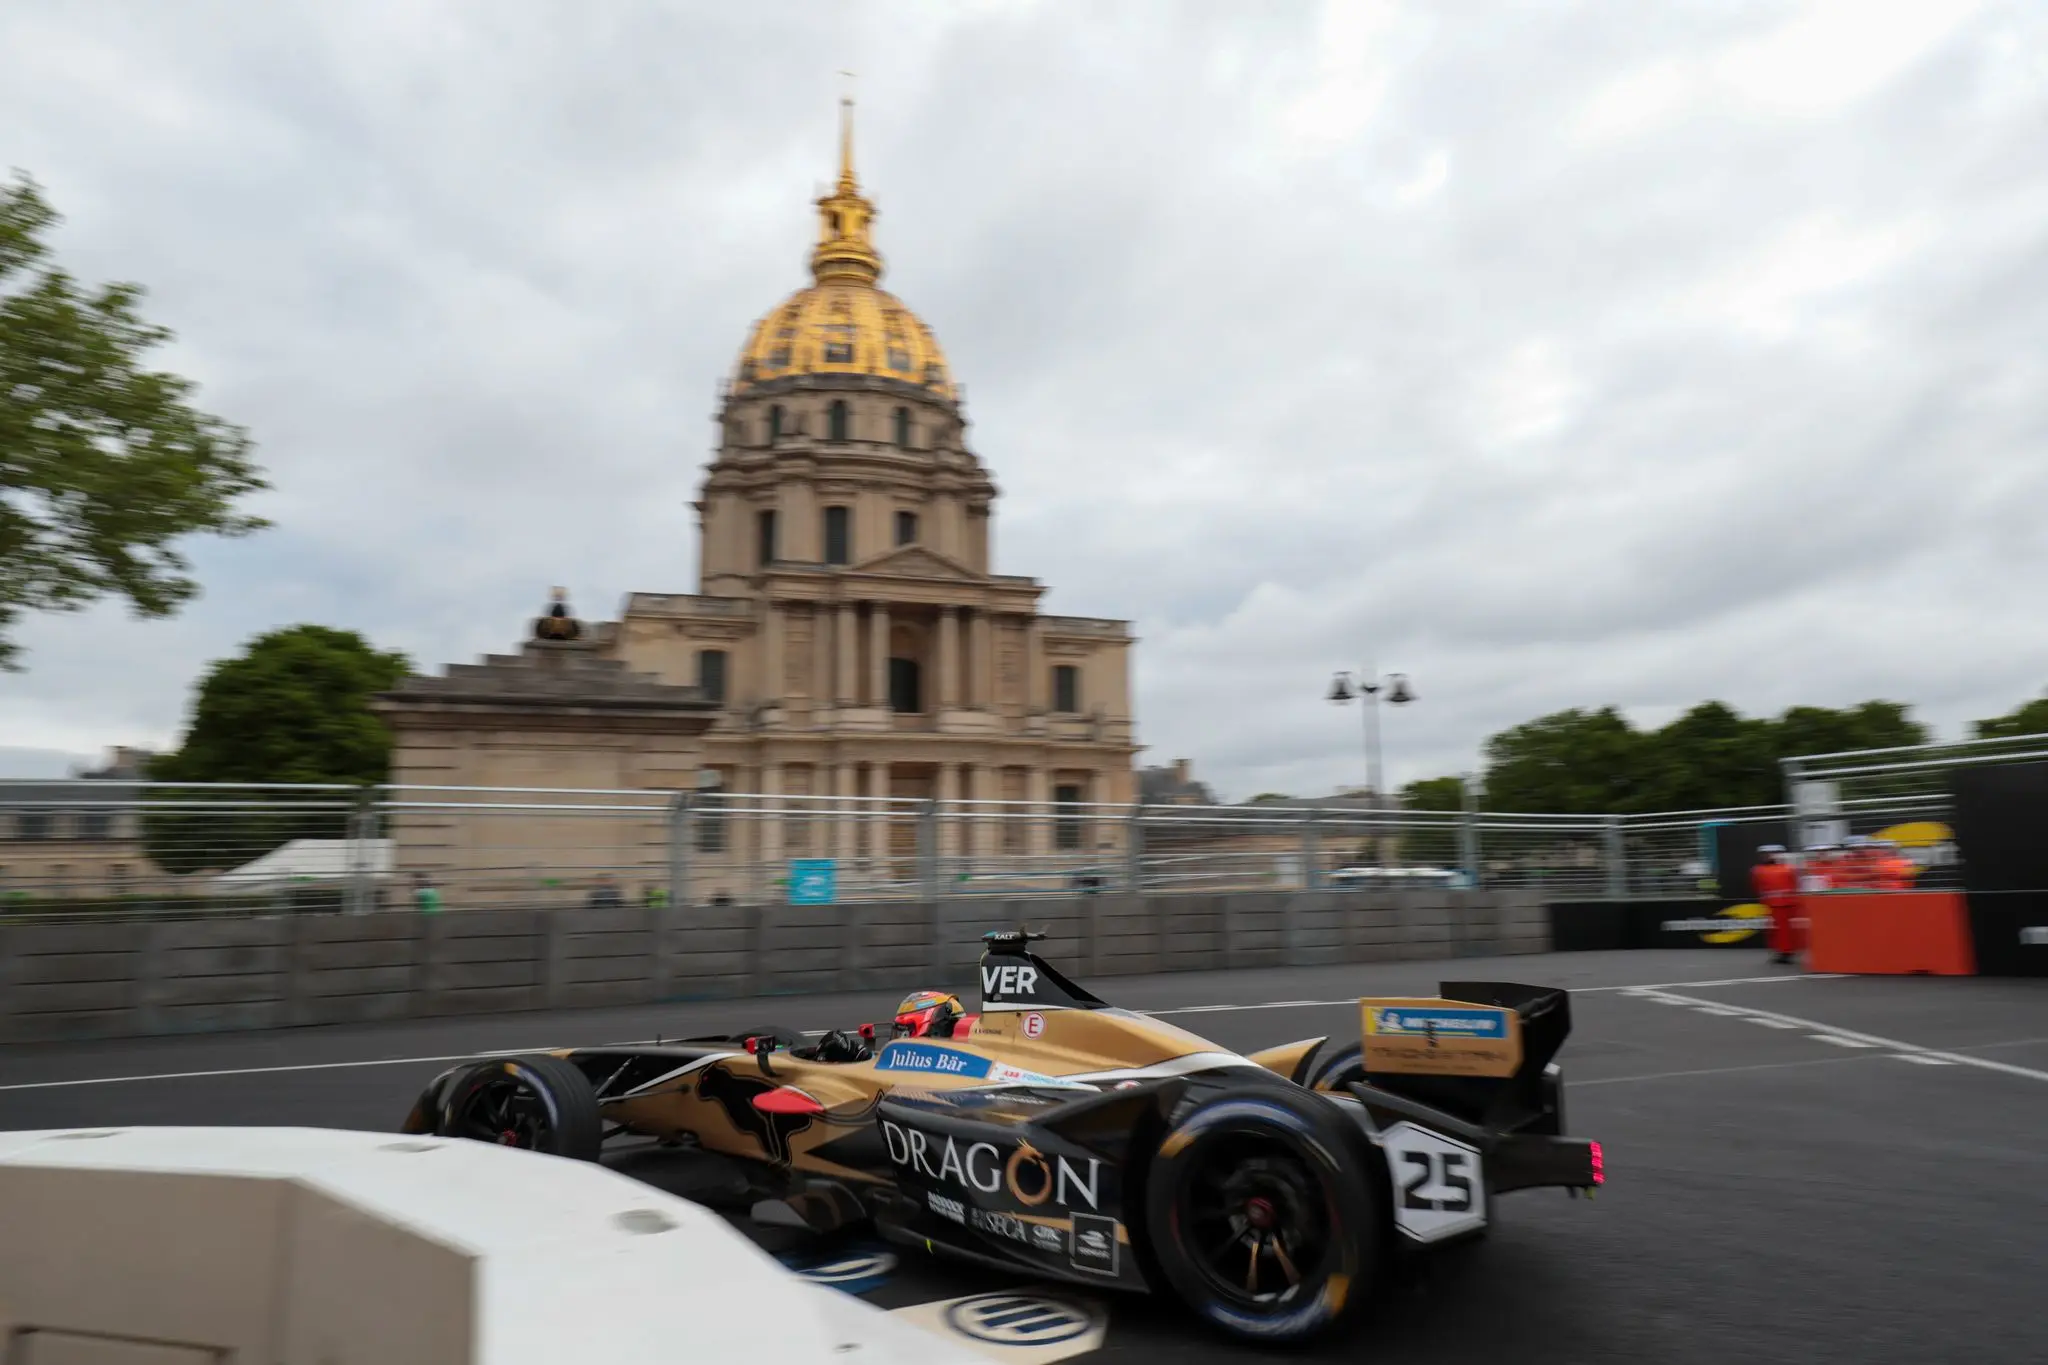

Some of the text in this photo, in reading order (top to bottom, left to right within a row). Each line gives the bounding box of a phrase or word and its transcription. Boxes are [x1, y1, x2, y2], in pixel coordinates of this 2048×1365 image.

[981, 966, 1038, 994] VER
[1028, 1016, 1039, 1034] E
[889, 1049, 967, 1072] Julius Bär
[882, 1120, 1100, 1210] DRAGON
[1402, 1151, 1471, 1211] 25
